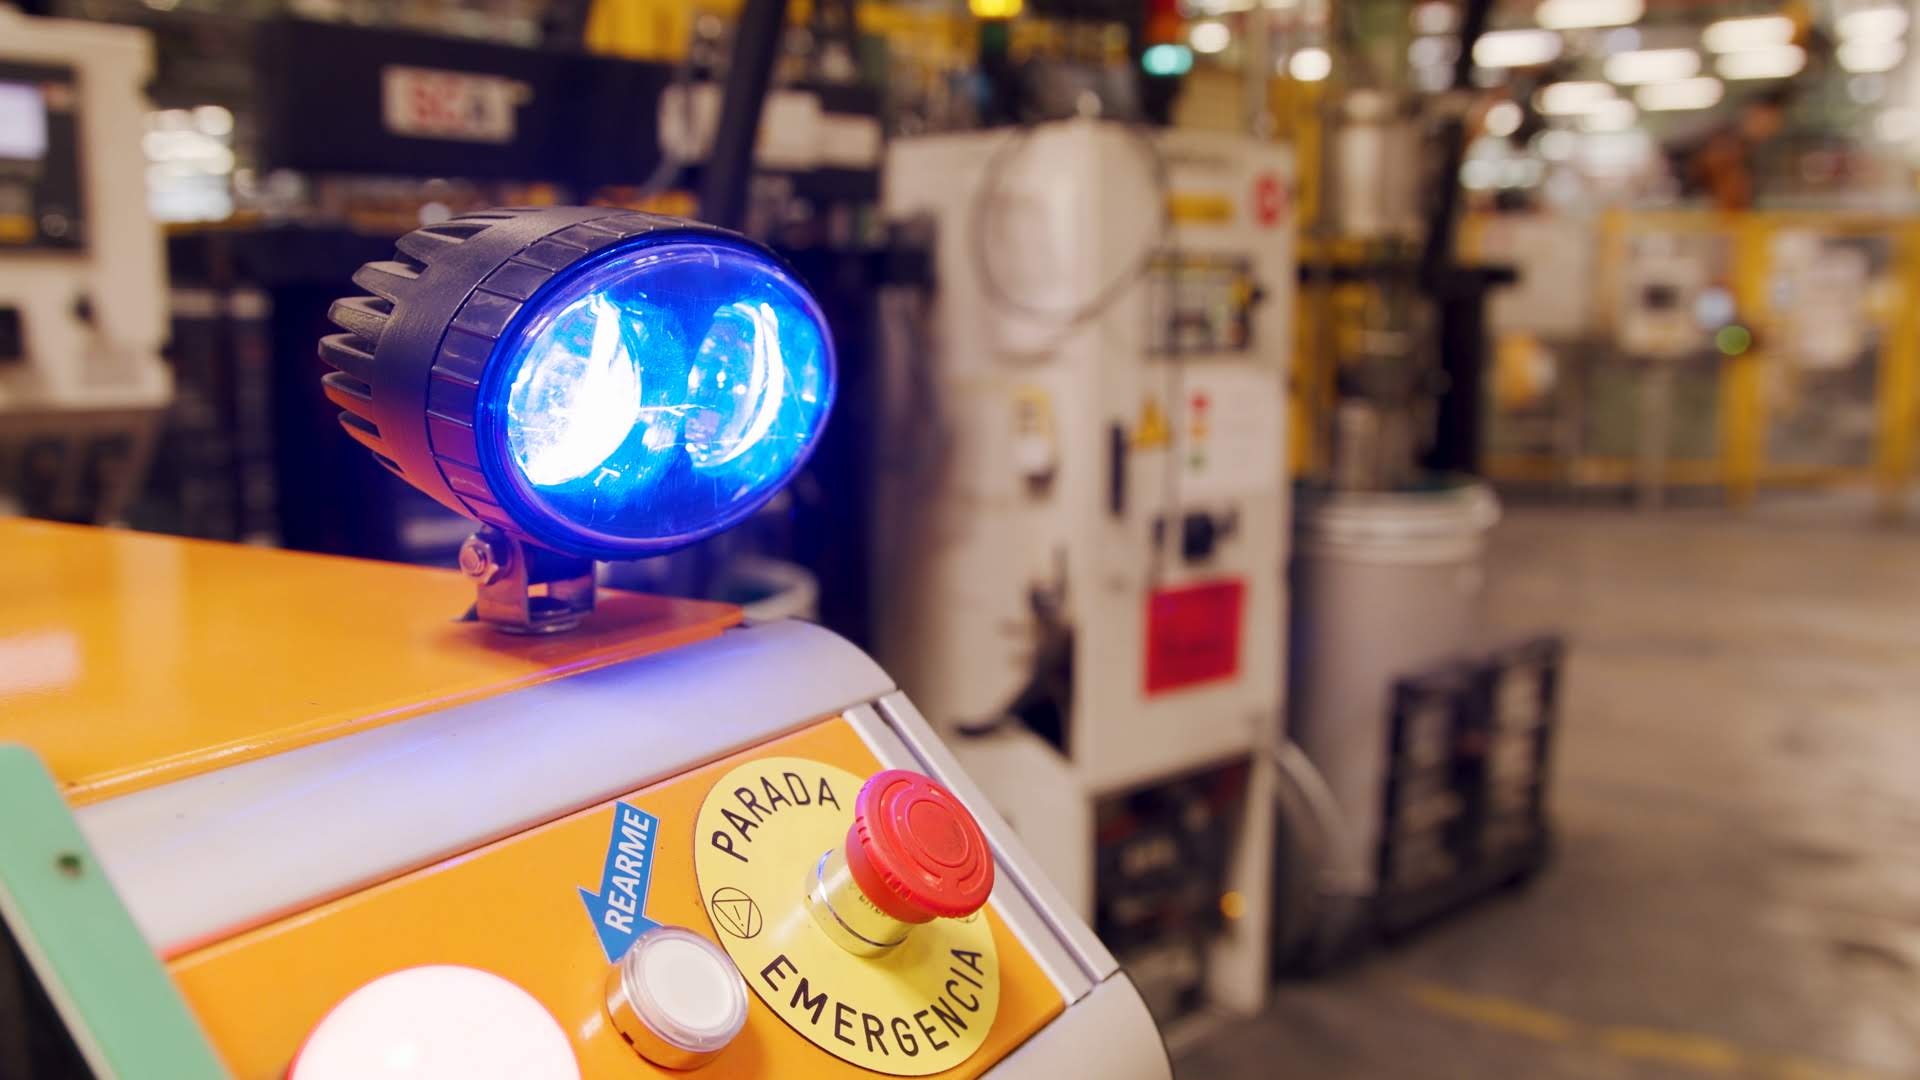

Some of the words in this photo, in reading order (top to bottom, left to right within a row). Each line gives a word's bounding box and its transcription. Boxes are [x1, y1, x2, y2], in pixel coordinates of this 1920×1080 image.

[712, 772, 841, 862] PARADA
[604, 809, 650, 935] REARME
[760, 949, 984, 1057] EMERGENCIA
